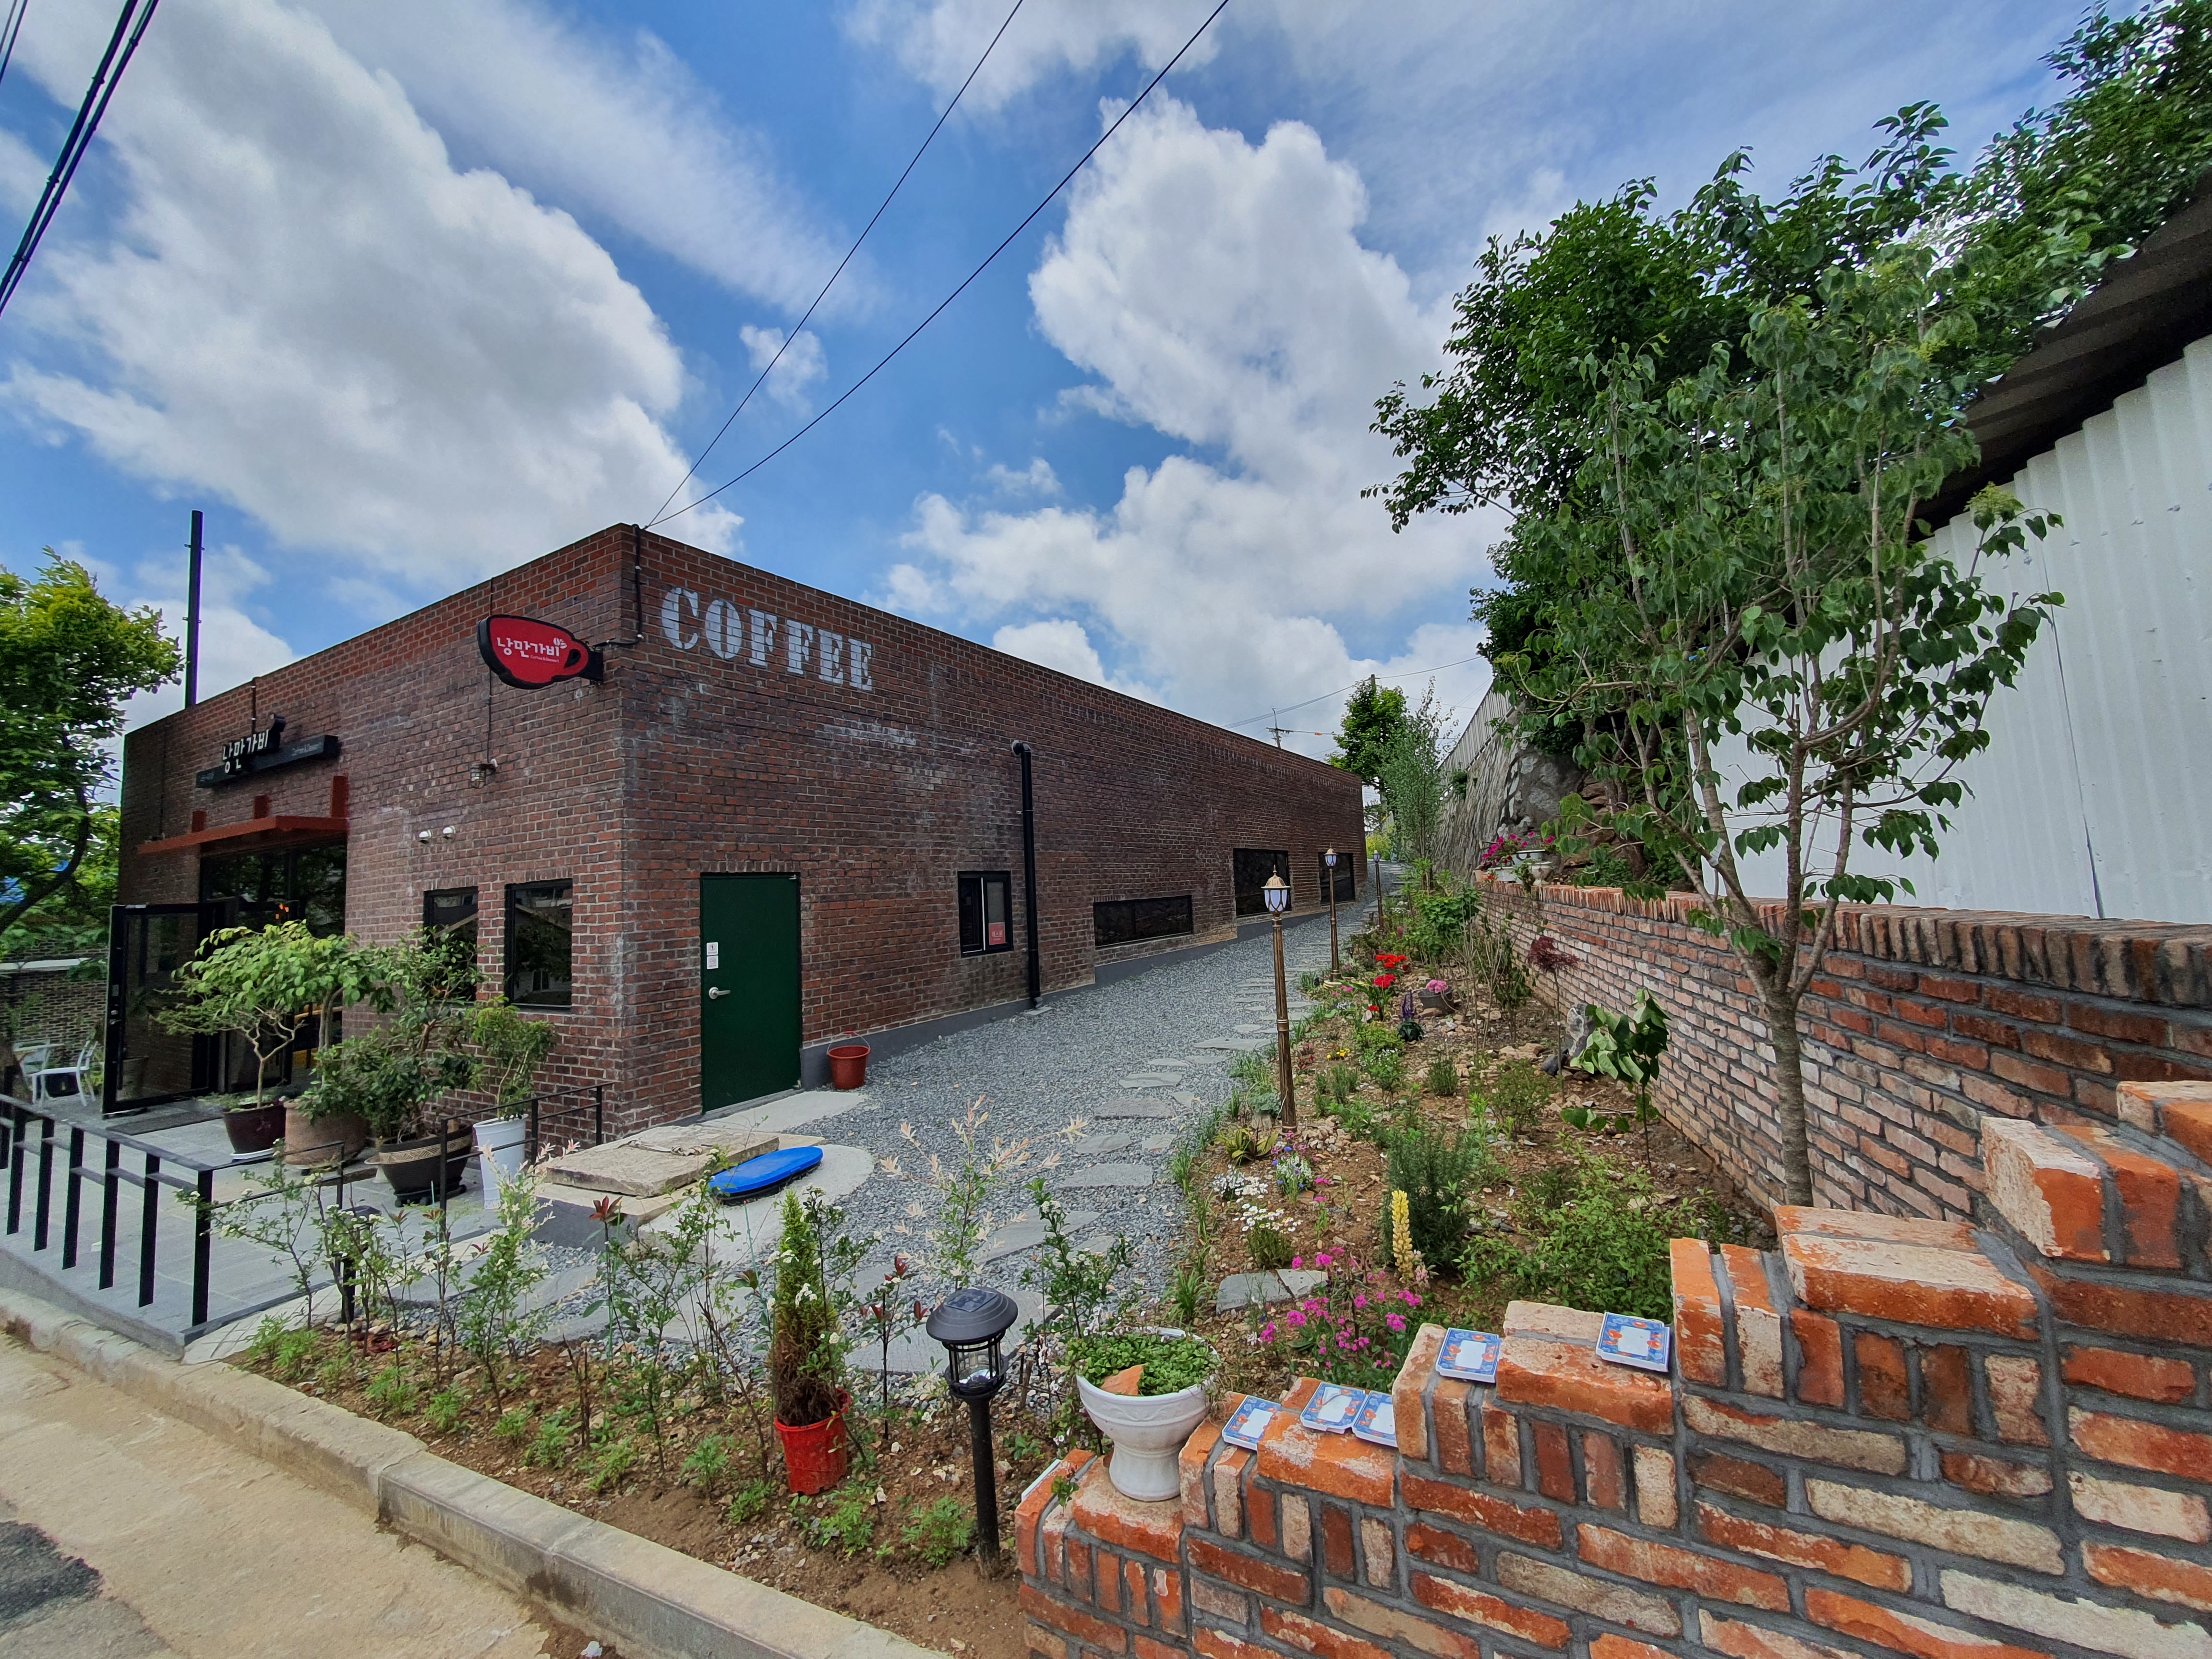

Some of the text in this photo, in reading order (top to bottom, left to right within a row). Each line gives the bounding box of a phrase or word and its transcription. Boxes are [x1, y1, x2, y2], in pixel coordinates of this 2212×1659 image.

[496, 637, 560, 658] 낭만가비
[661, 587, 872, 691] COFFEE
[222, 729, 269, 774] 낭만가비
